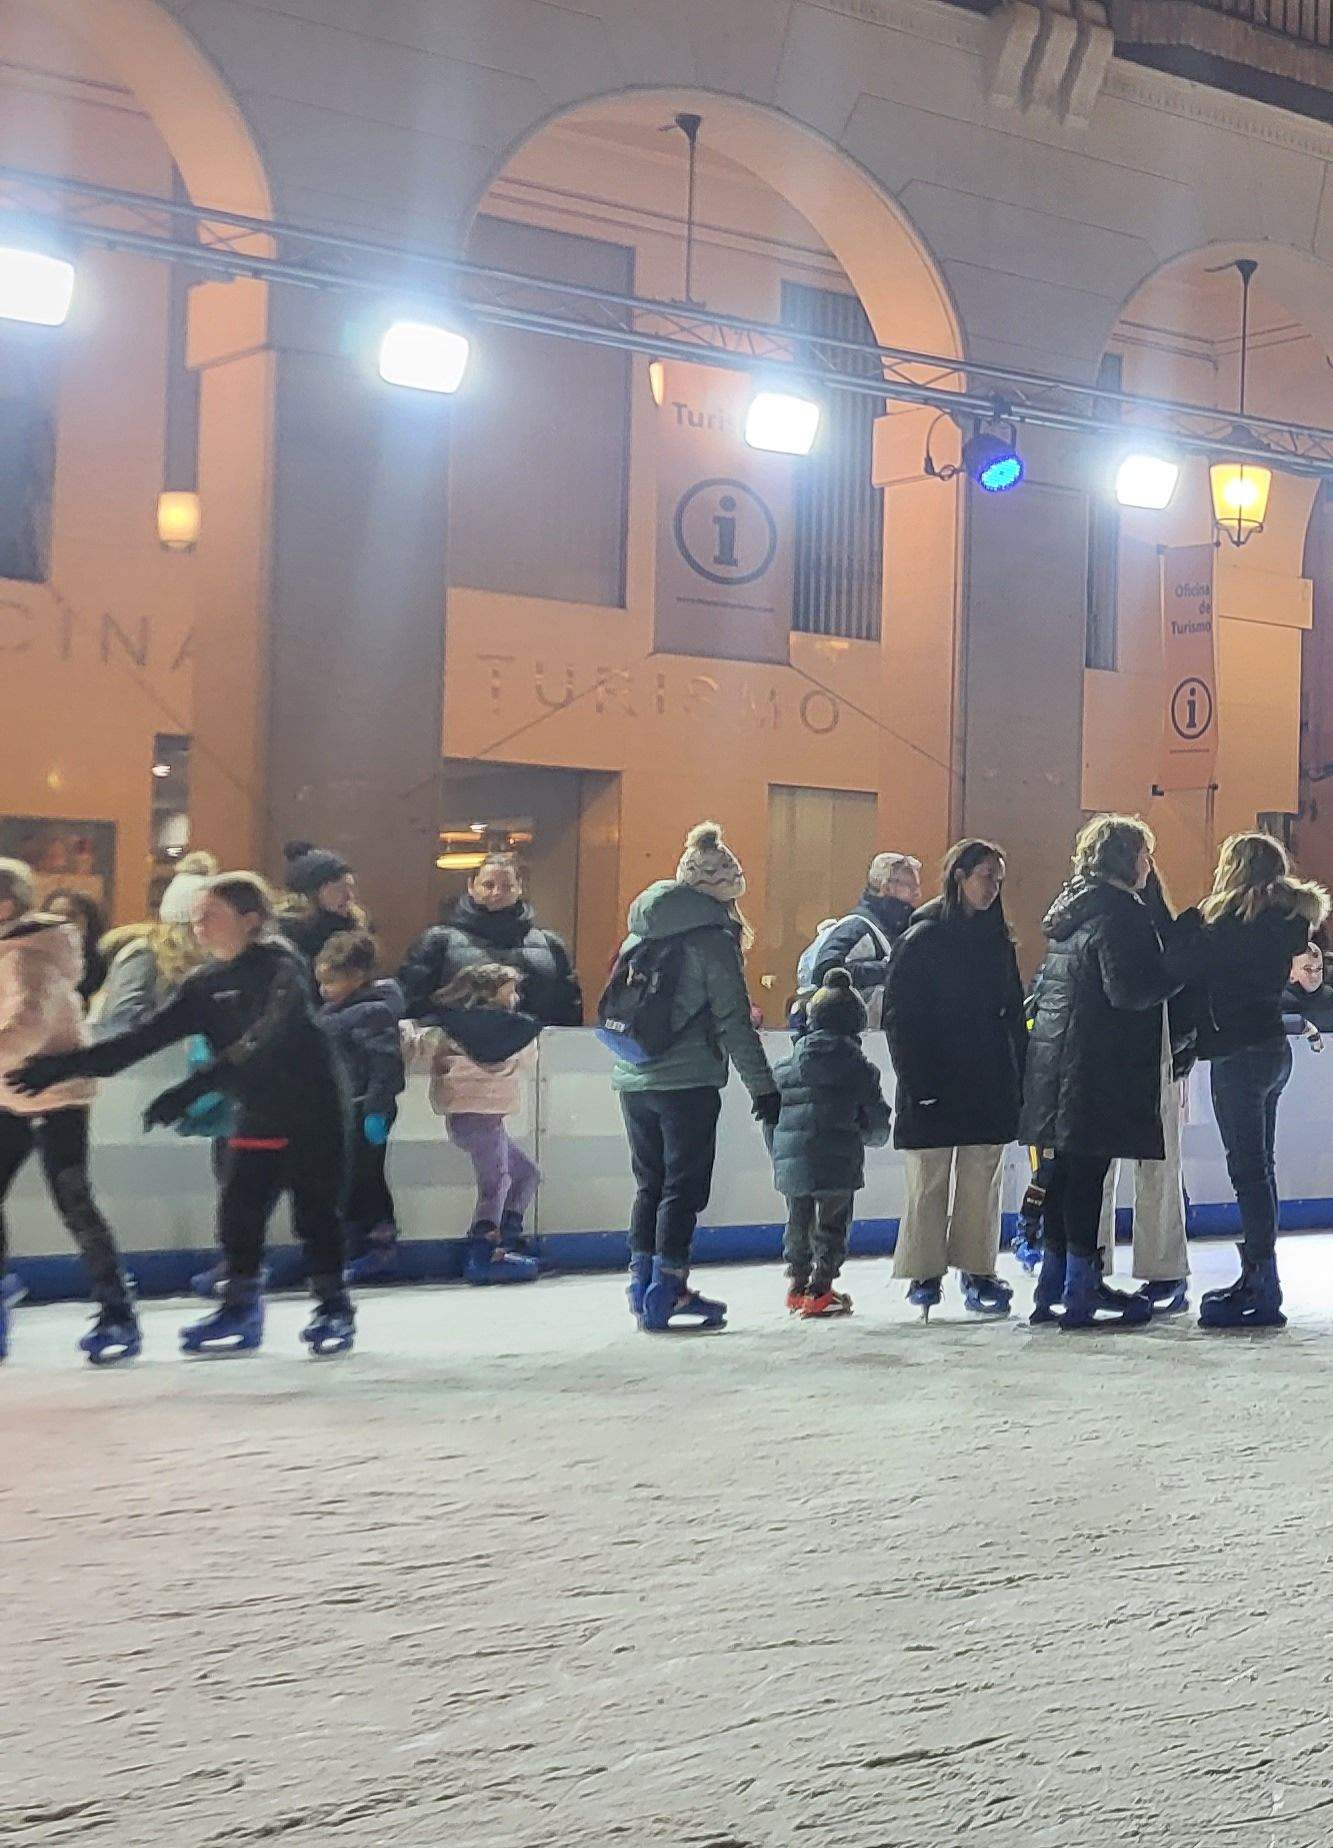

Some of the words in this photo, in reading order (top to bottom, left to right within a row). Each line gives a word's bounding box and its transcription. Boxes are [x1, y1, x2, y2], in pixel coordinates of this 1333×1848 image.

[1175, 582, 1210, 597] Oficina
[1199, 600, 1211, 614] de
[1171, 620, 1212, 634] Turismo
